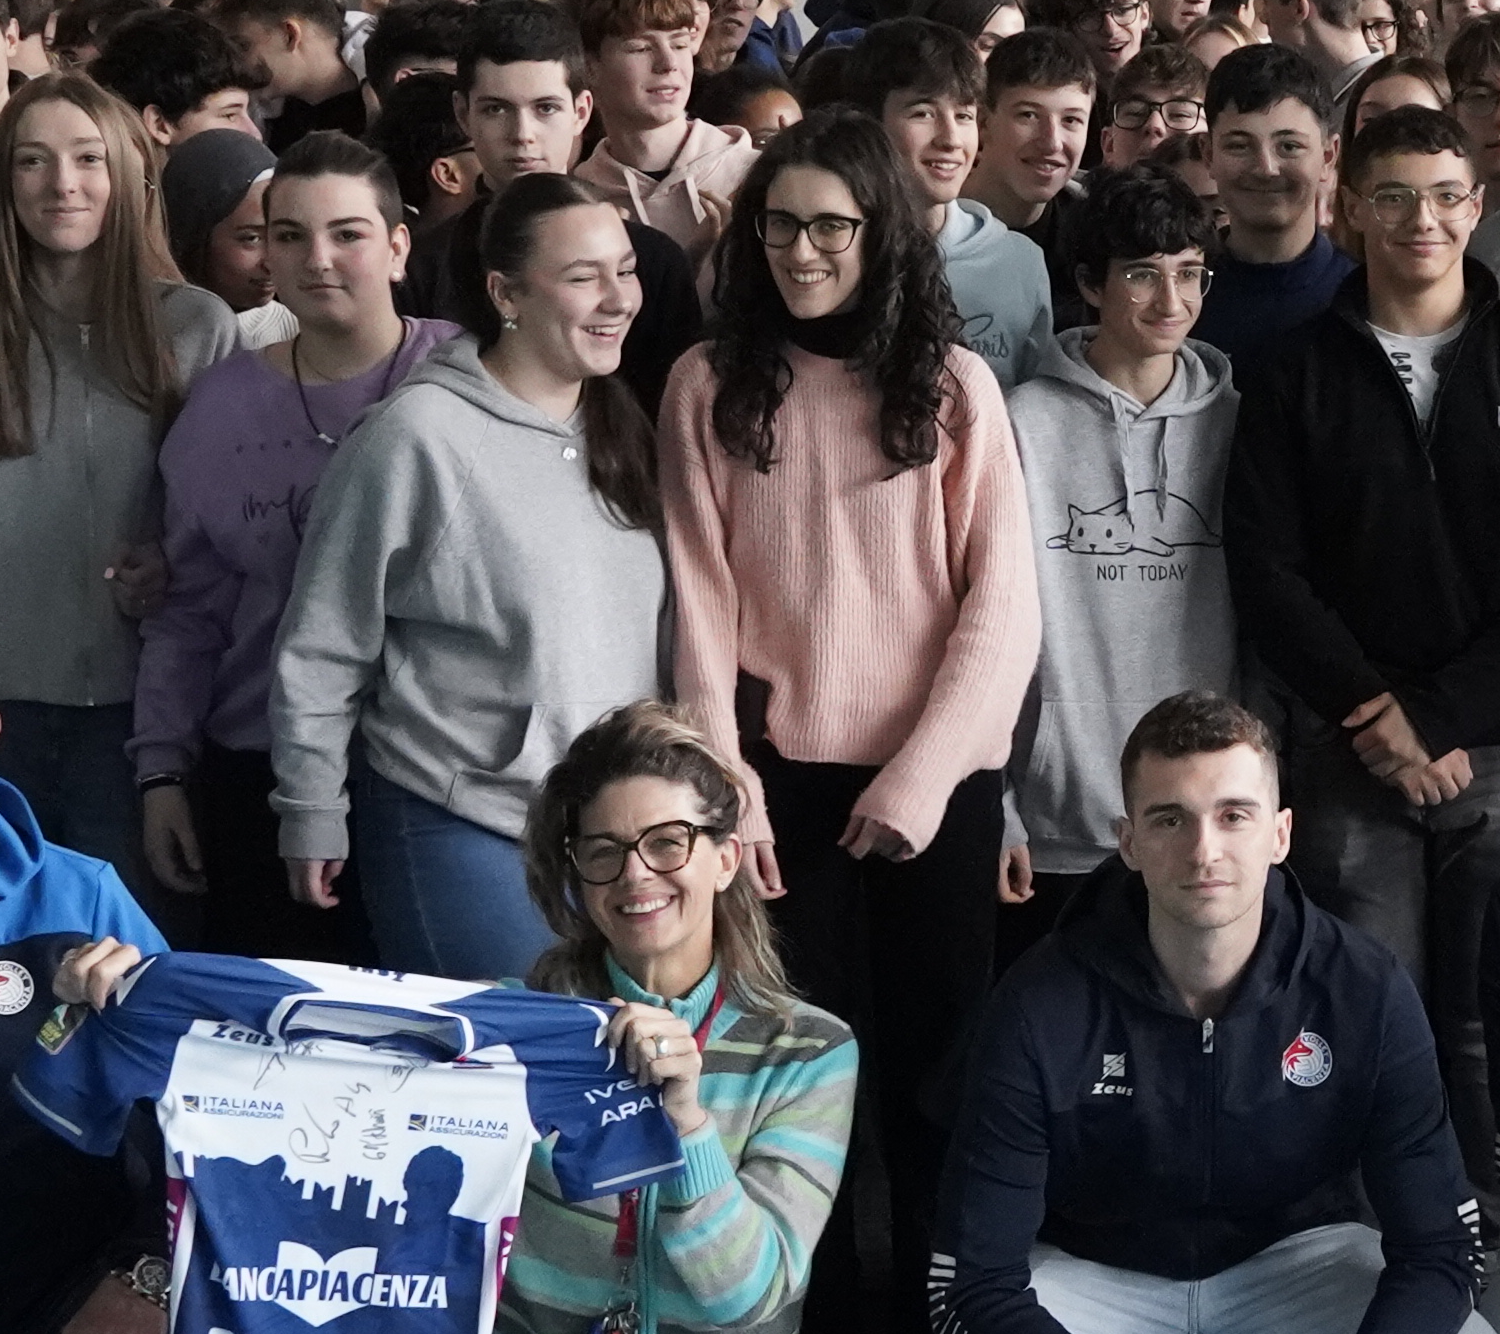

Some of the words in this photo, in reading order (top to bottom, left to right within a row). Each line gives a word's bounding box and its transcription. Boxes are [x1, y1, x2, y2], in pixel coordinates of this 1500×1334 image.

[1097, 564, 1129, 581] NOT
[1137, 563, 1189, 582] TODAY
[210, 1023, 276, 1048] Zeus
[584, 1078, 638, 1105] IVE
[1090, 1082, 1134, 1097] Zeus
[202, 1096, 285, 1112] ITALIANA
[202, 1106, 285, 1120] ASSICURAZIONI
[430, 1114, 510, 1132] ITALIANA
[428, 1126, 508, 1140] ASSICURAZIONI
